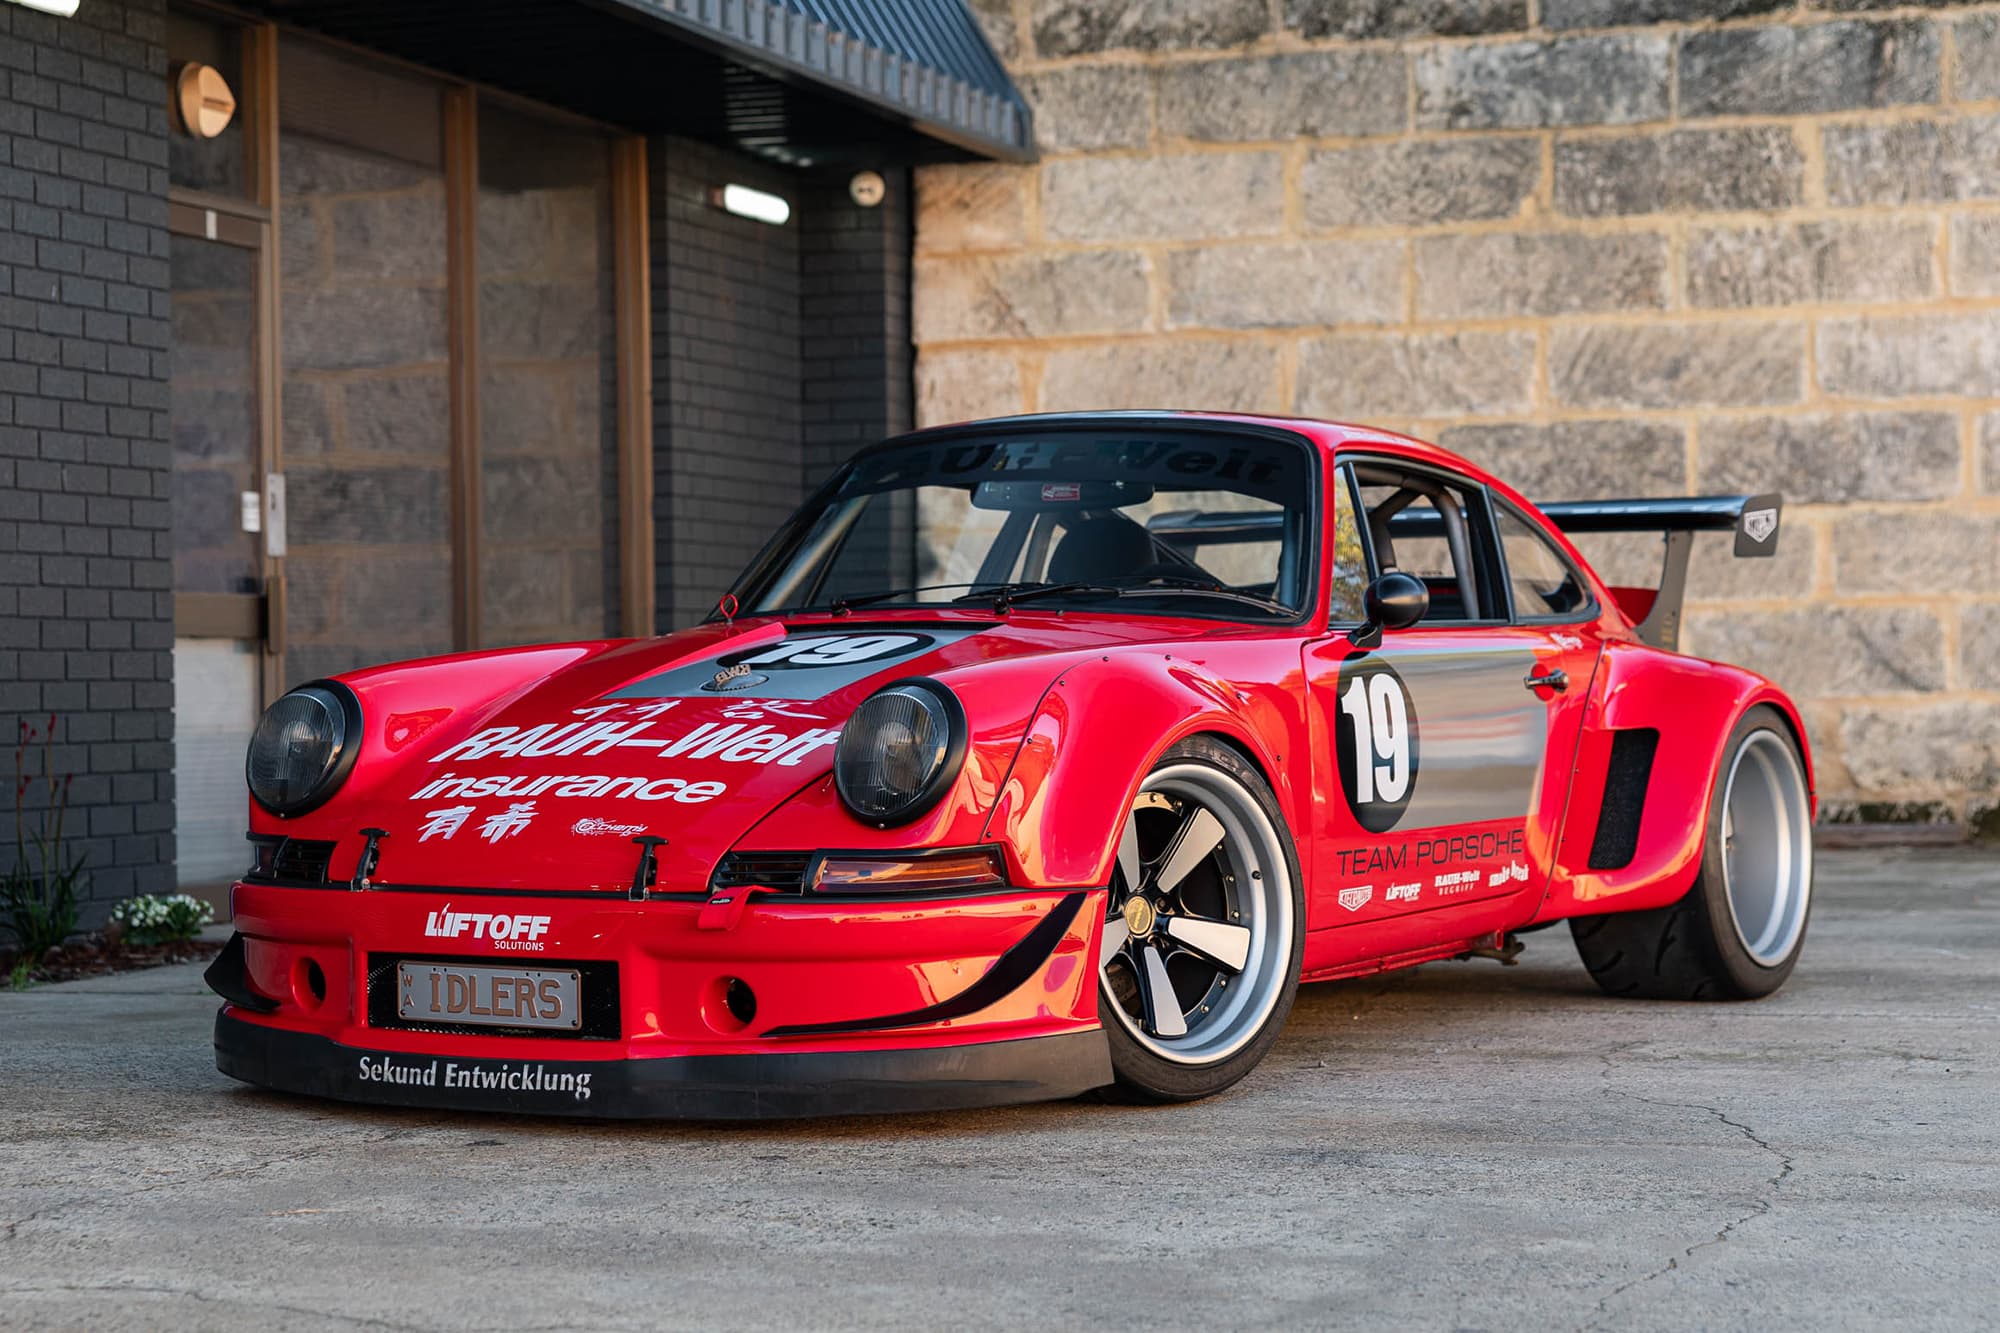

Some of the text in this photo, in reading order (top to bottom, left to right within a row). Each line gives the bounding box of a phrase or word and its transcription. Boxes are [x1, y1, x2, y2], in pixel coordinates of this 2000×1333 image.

[740, 634, 920, 664] 19
[428, 721, 841, 767] RAUH-Welt
[1341, 673, 1409, 803] 19
[410, 772, 727, 803] insurance
[1337, 829, 1523, 876] TEAM PORSCHE
[424, 903, 551, 941] LIFTOFF
[494, 940, 544, 951] SOLUTIONS
[430, 972, 563, 1019] IDLERS
[359, 1056, 592, 1100] Sekund Entwicklung
